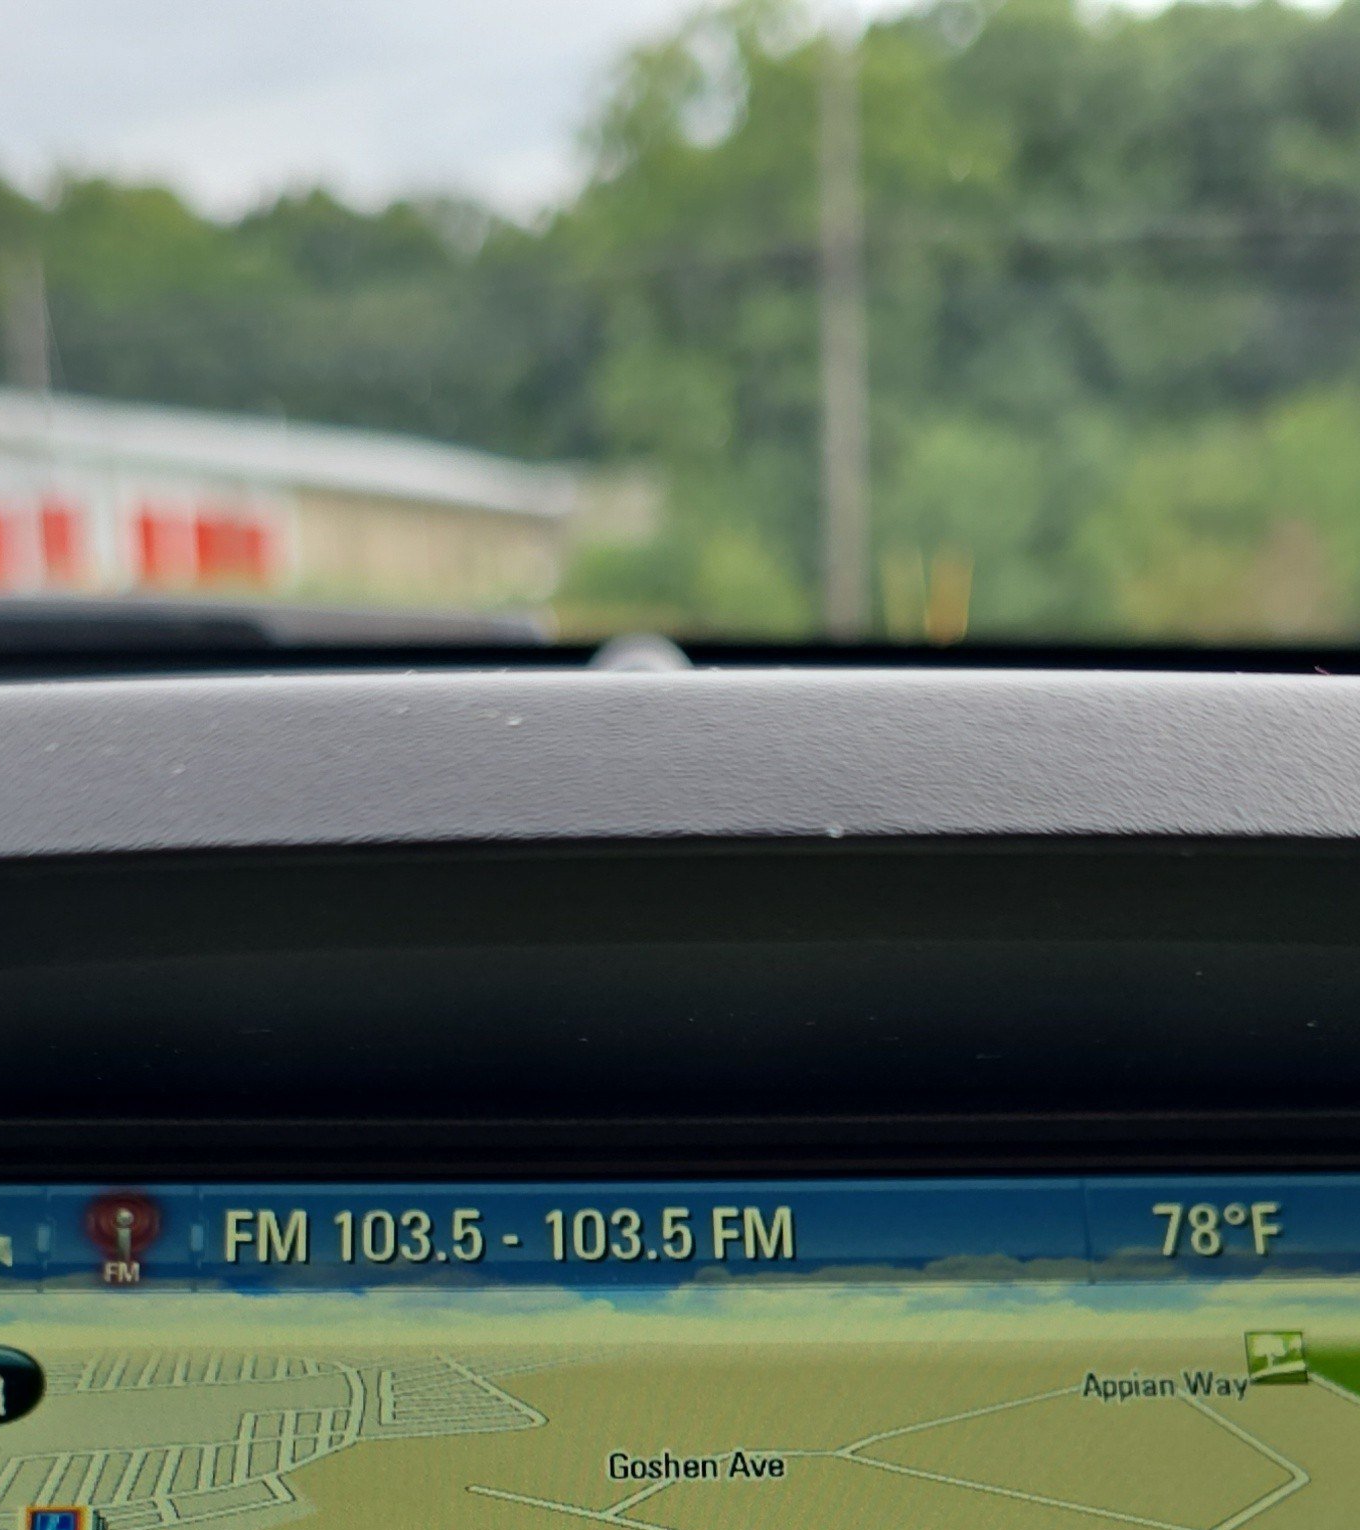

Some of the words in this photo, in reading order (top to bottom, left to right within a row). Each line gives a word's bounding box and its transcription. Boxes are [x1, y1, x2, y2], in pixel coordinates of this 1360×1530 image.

[225, 1208, 311, 1263] FM
[336, 1209, 484, 1263] 103.5
[545, 1208, 694, 1262] 103.5
[712, 1206, 795, 1260] FM
[1152, 1203, 1282, 1257] 78°F
[104, 1263, 140, 1283] FM
[1083, 1373, 1176, 1400] Appian
[1182, 1371, 1248, 1401] Way
[610, 1453, 717, 1480] Goshen
[729, 1452, 785, 1478] Ave
